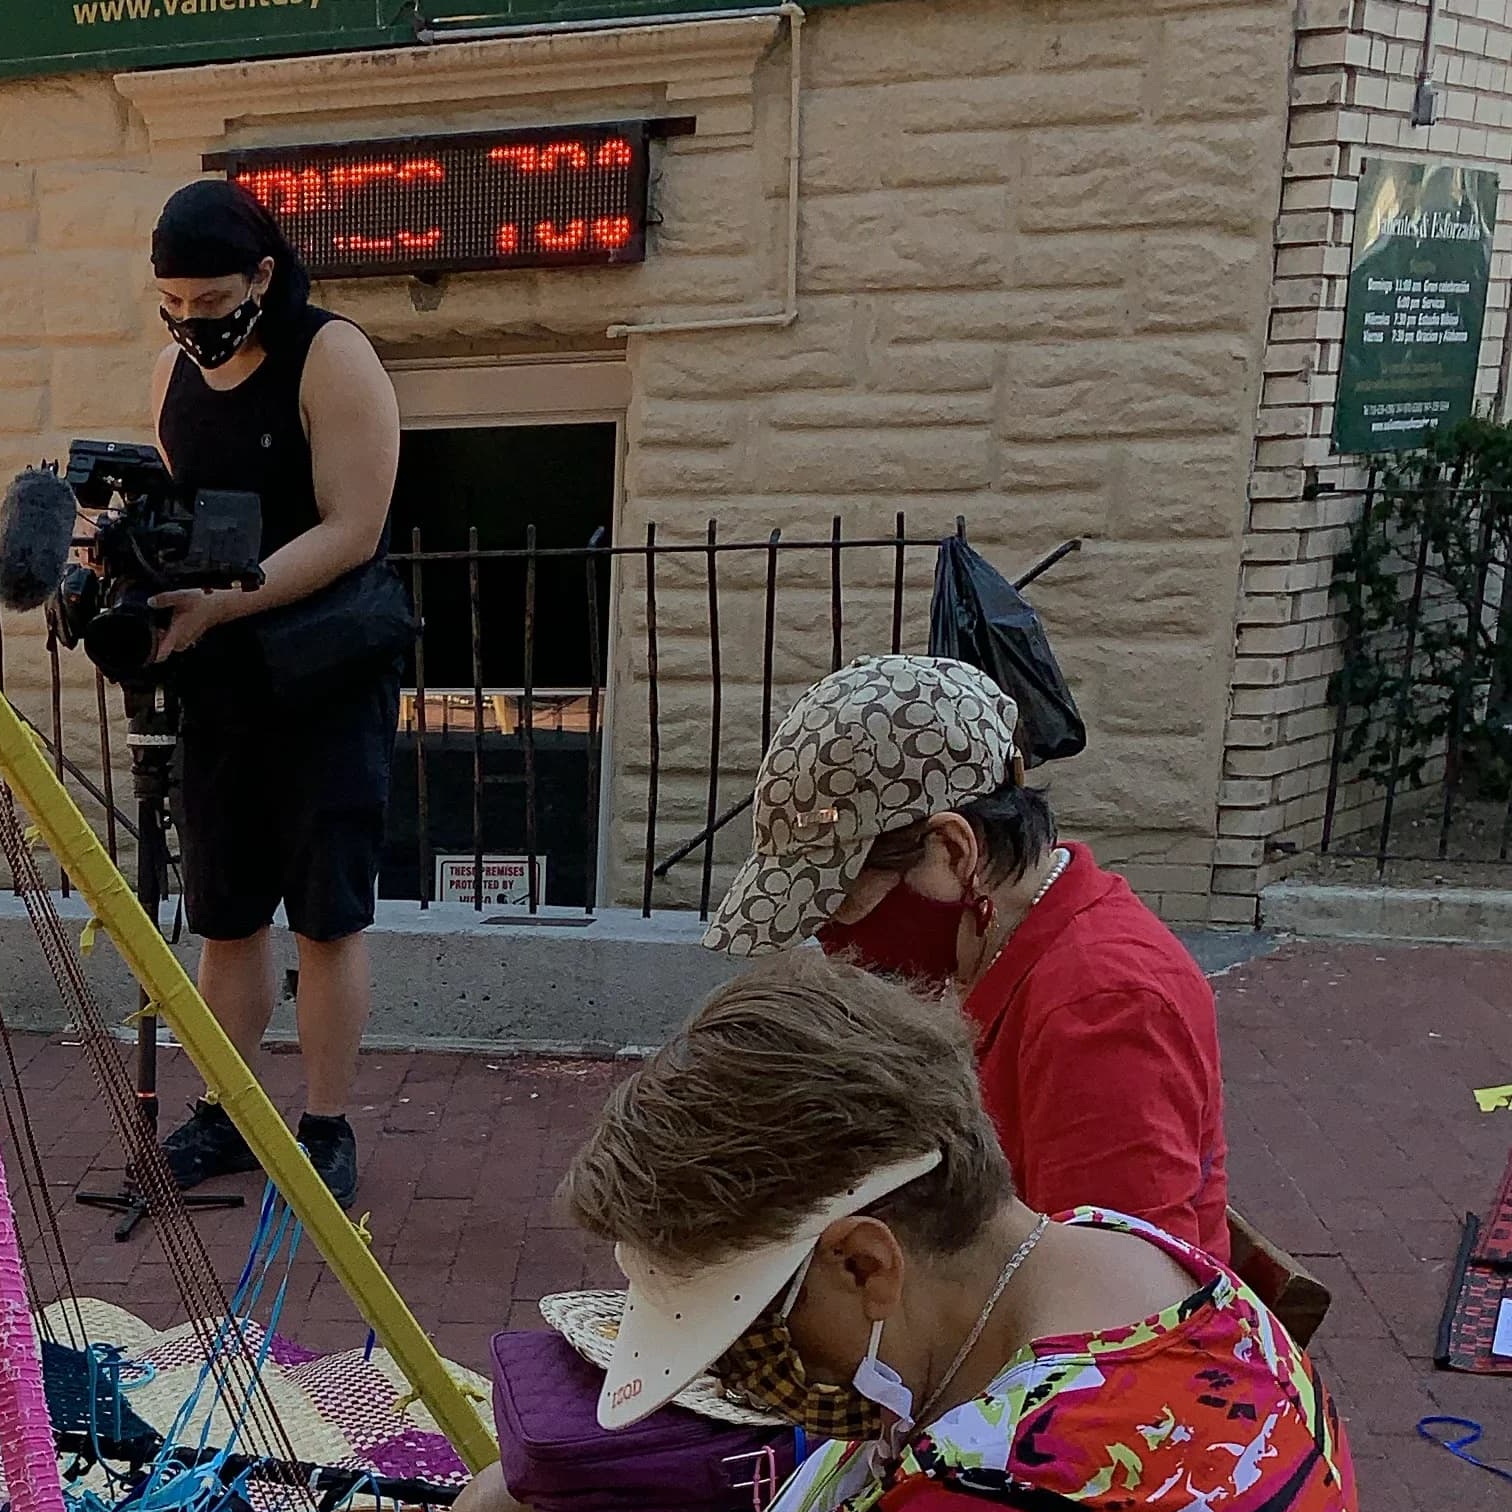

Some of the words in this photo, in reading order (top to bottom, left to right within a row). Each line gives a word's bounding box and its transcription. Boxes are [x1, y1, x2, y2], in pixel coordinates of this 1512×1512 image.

[449, 880, 499, 890] PROTTED
[502, 880, 514, 890] BY
[459, 895, 492, 904] VIDO
[612, 1378, 642, 1408] IZOD
